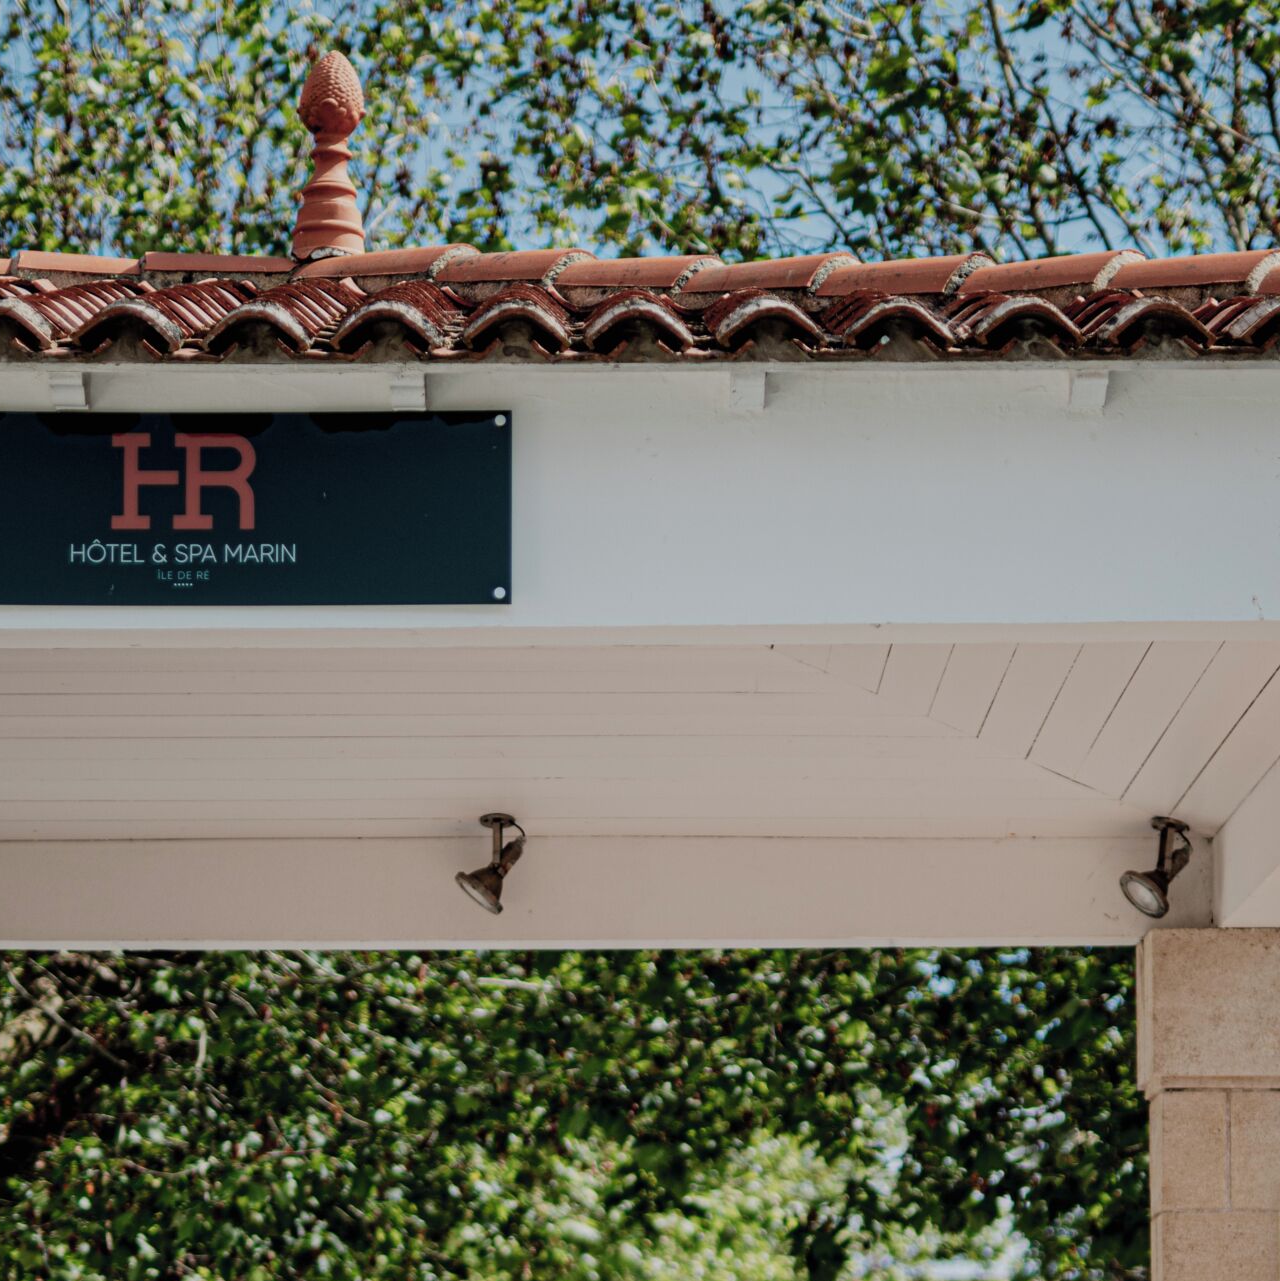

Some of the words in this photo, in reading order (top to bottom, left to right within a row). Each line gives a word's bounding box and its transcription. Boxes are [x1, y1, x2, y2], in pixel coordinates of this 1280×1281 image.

[111, 433, 256, 529] HR
[70, 538, 144, 563] HÔTEL
[151, 543, 168, 563] &
[174, 543, 217, 563] SPA
[224, 543, 297, 563] MARIN
[157, 569, 174, 580] ÎLE
[177, 570, 193, 580] DE
[196, 569, 210, 580] RÉ
